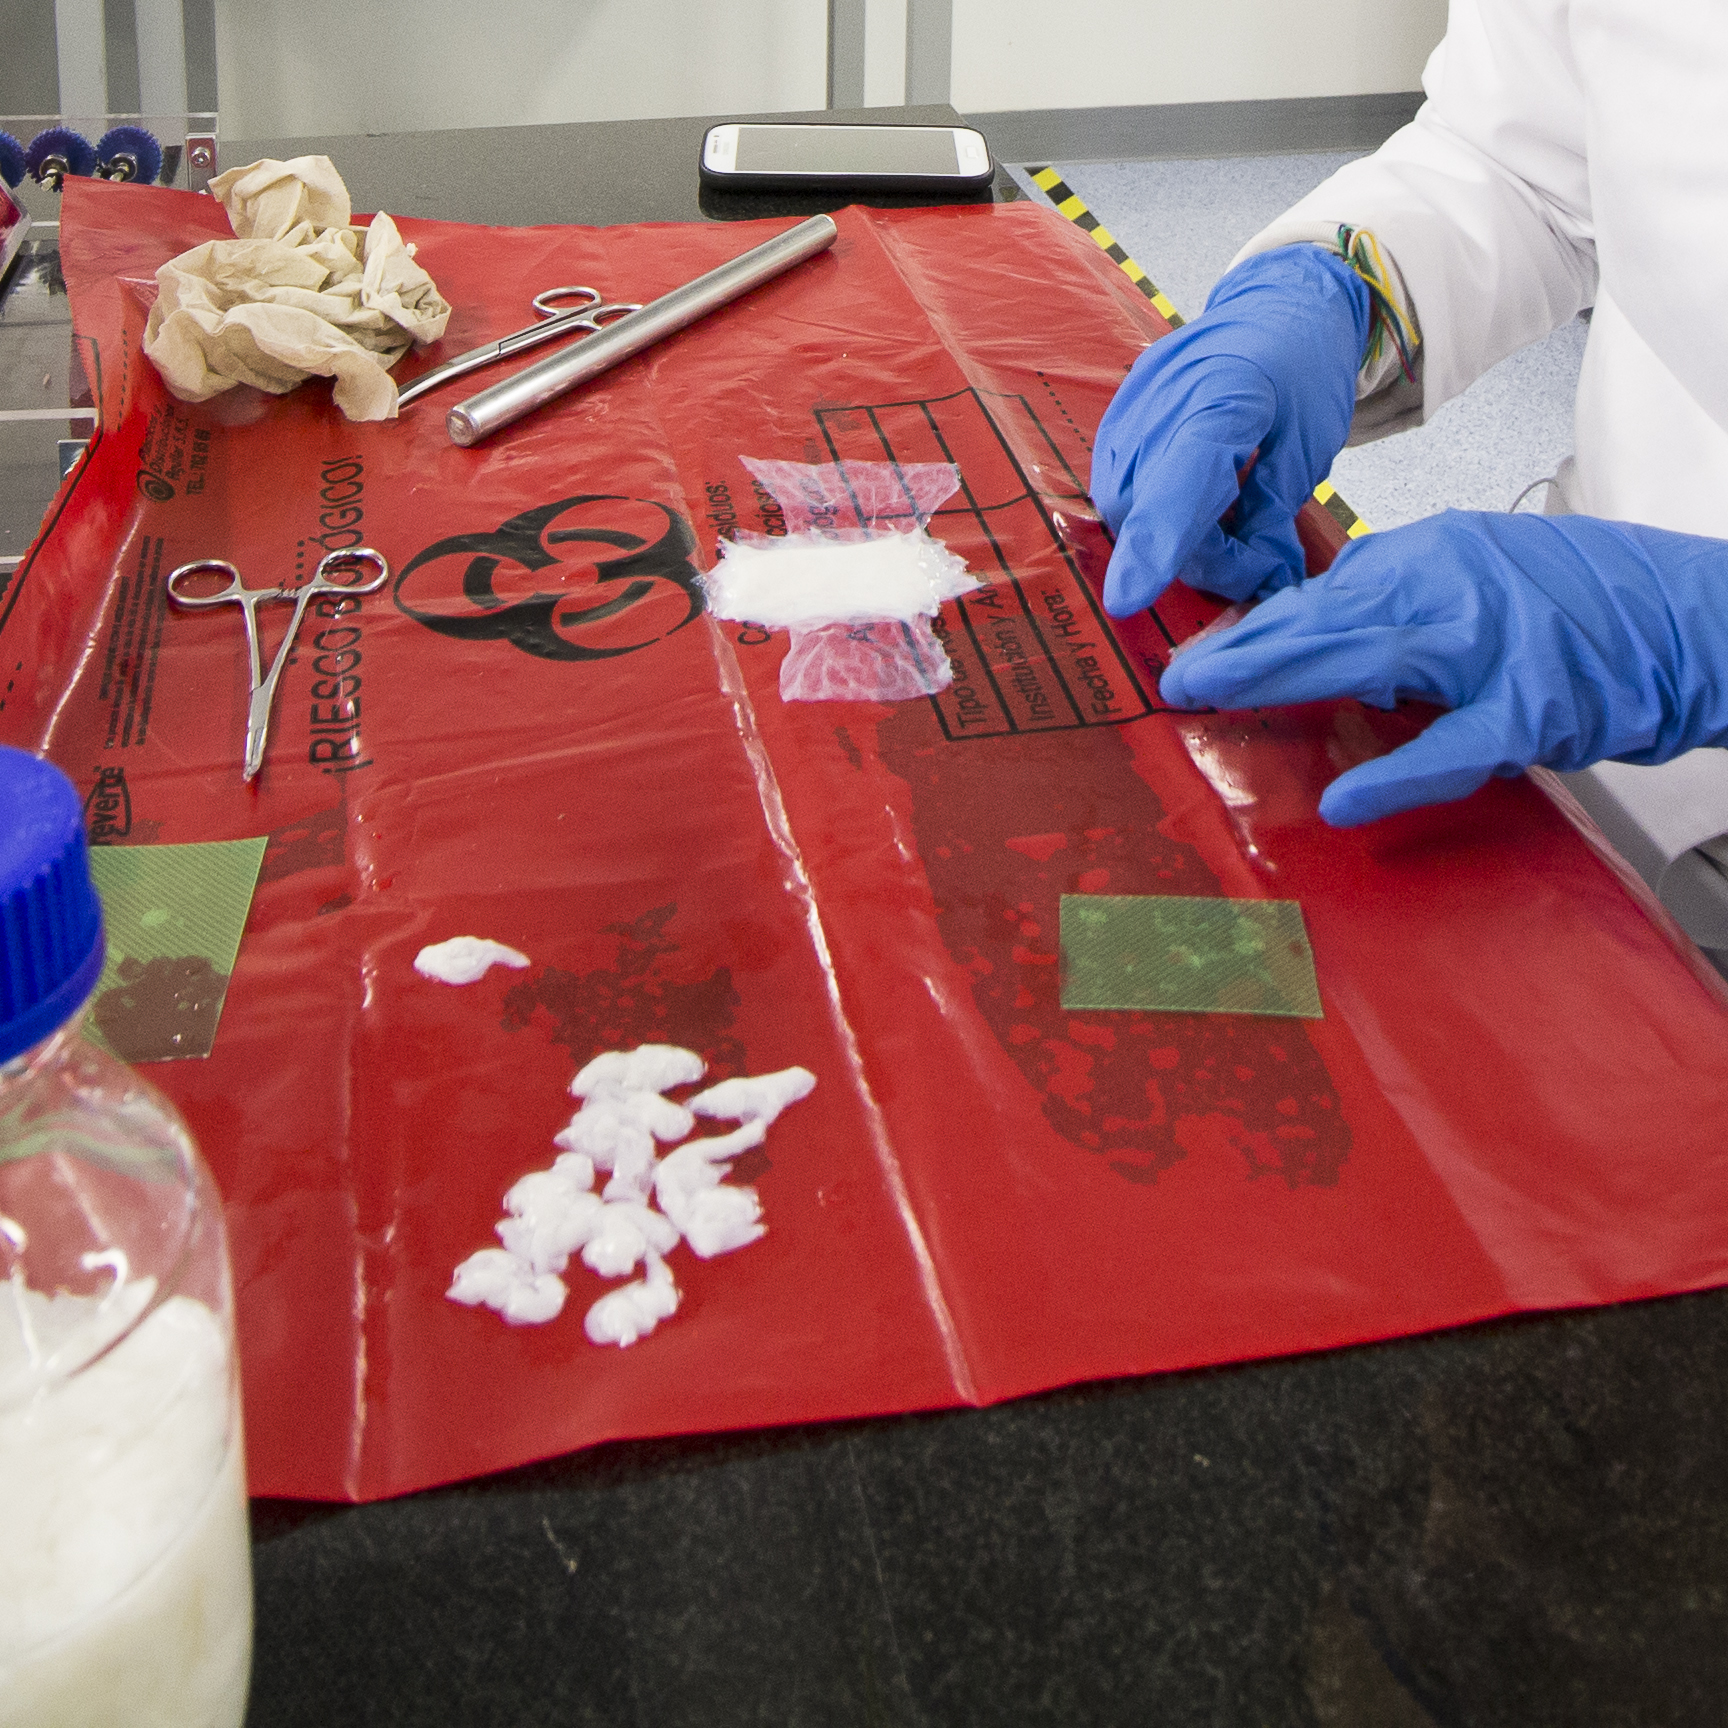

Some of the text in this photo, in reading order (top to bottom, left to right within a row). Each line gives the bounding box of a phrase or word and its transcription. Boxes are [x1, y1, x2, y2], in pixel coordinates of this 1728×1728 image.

[308, 454, 373, 775] ¡RIESGO BOÓGICO!
[986, 613, 1016, 626] y
[1040, 590, 1122, 715] Fecha y Hora:
[951, 686, 988, 729] Tipo
[991, 630, 1055, 723] Institución
